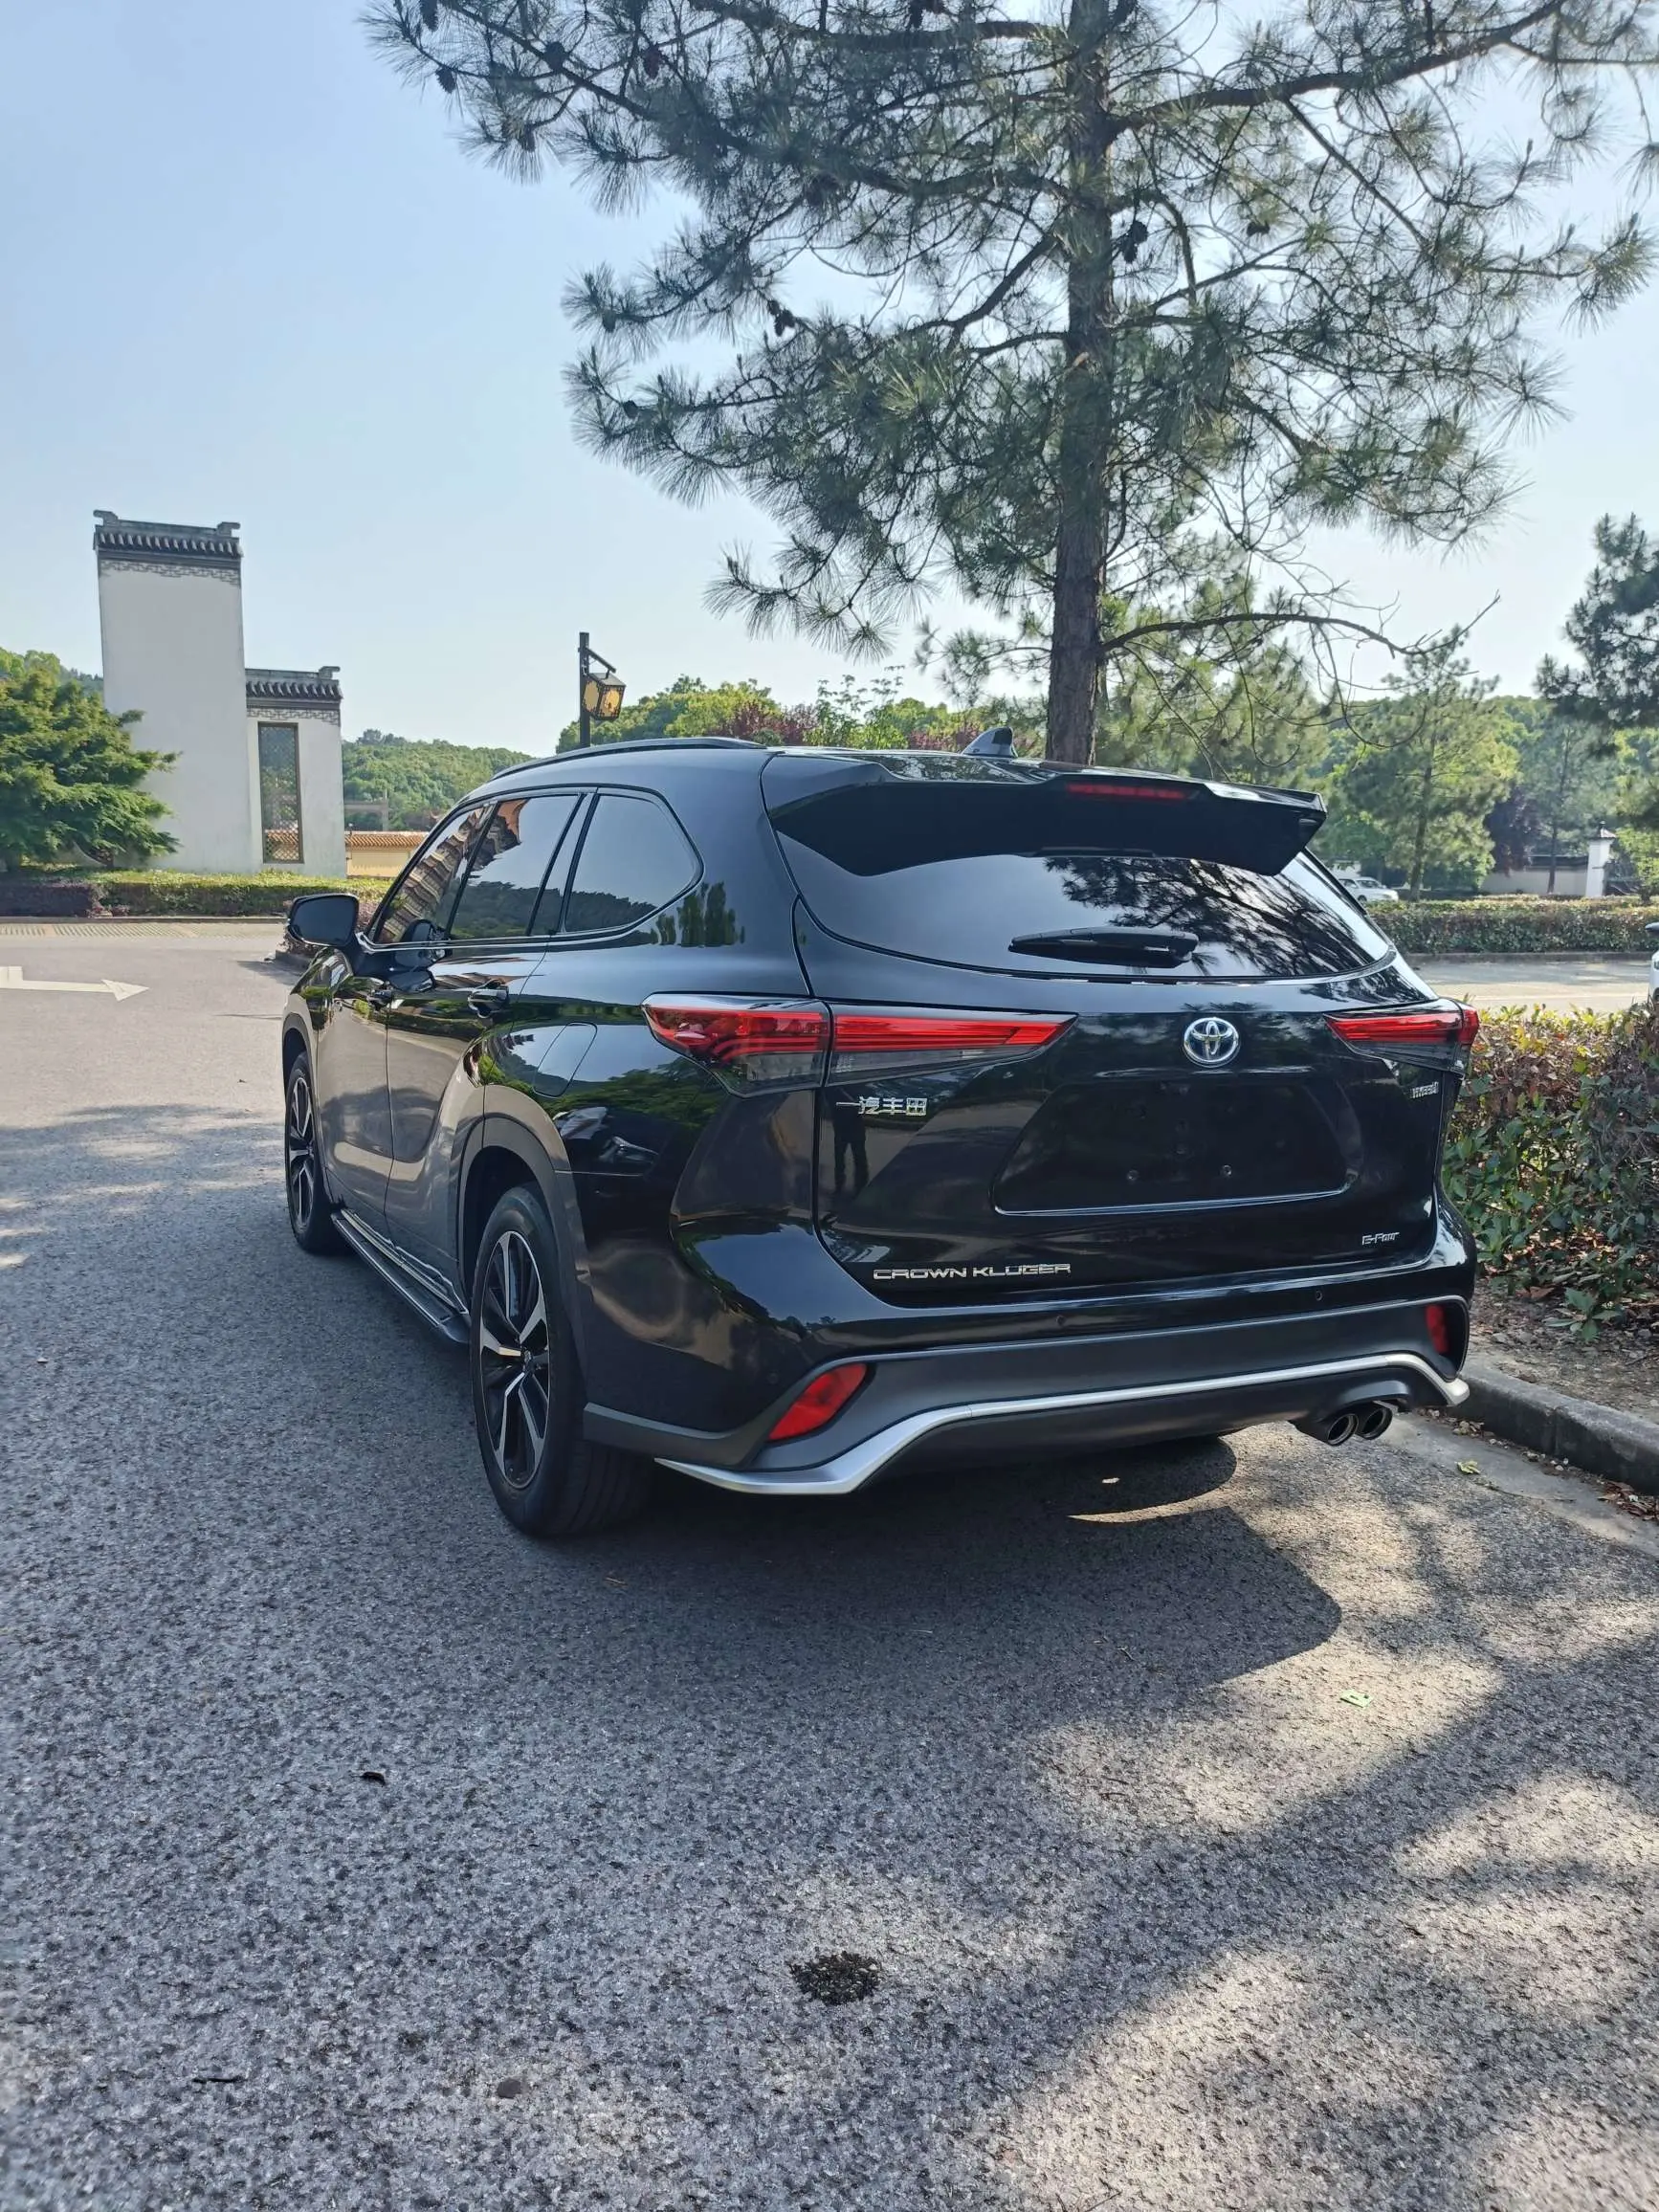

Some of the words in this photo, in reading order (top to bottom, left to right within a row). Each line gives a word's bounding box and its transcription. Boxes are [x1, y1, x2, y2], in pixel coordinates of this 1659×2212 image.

[836, 1095, 928, 1117] 一汽丰田
[873, 1268, 967, 1280] CROWN
[972, 1263, 1071, 1277] KLUGER
